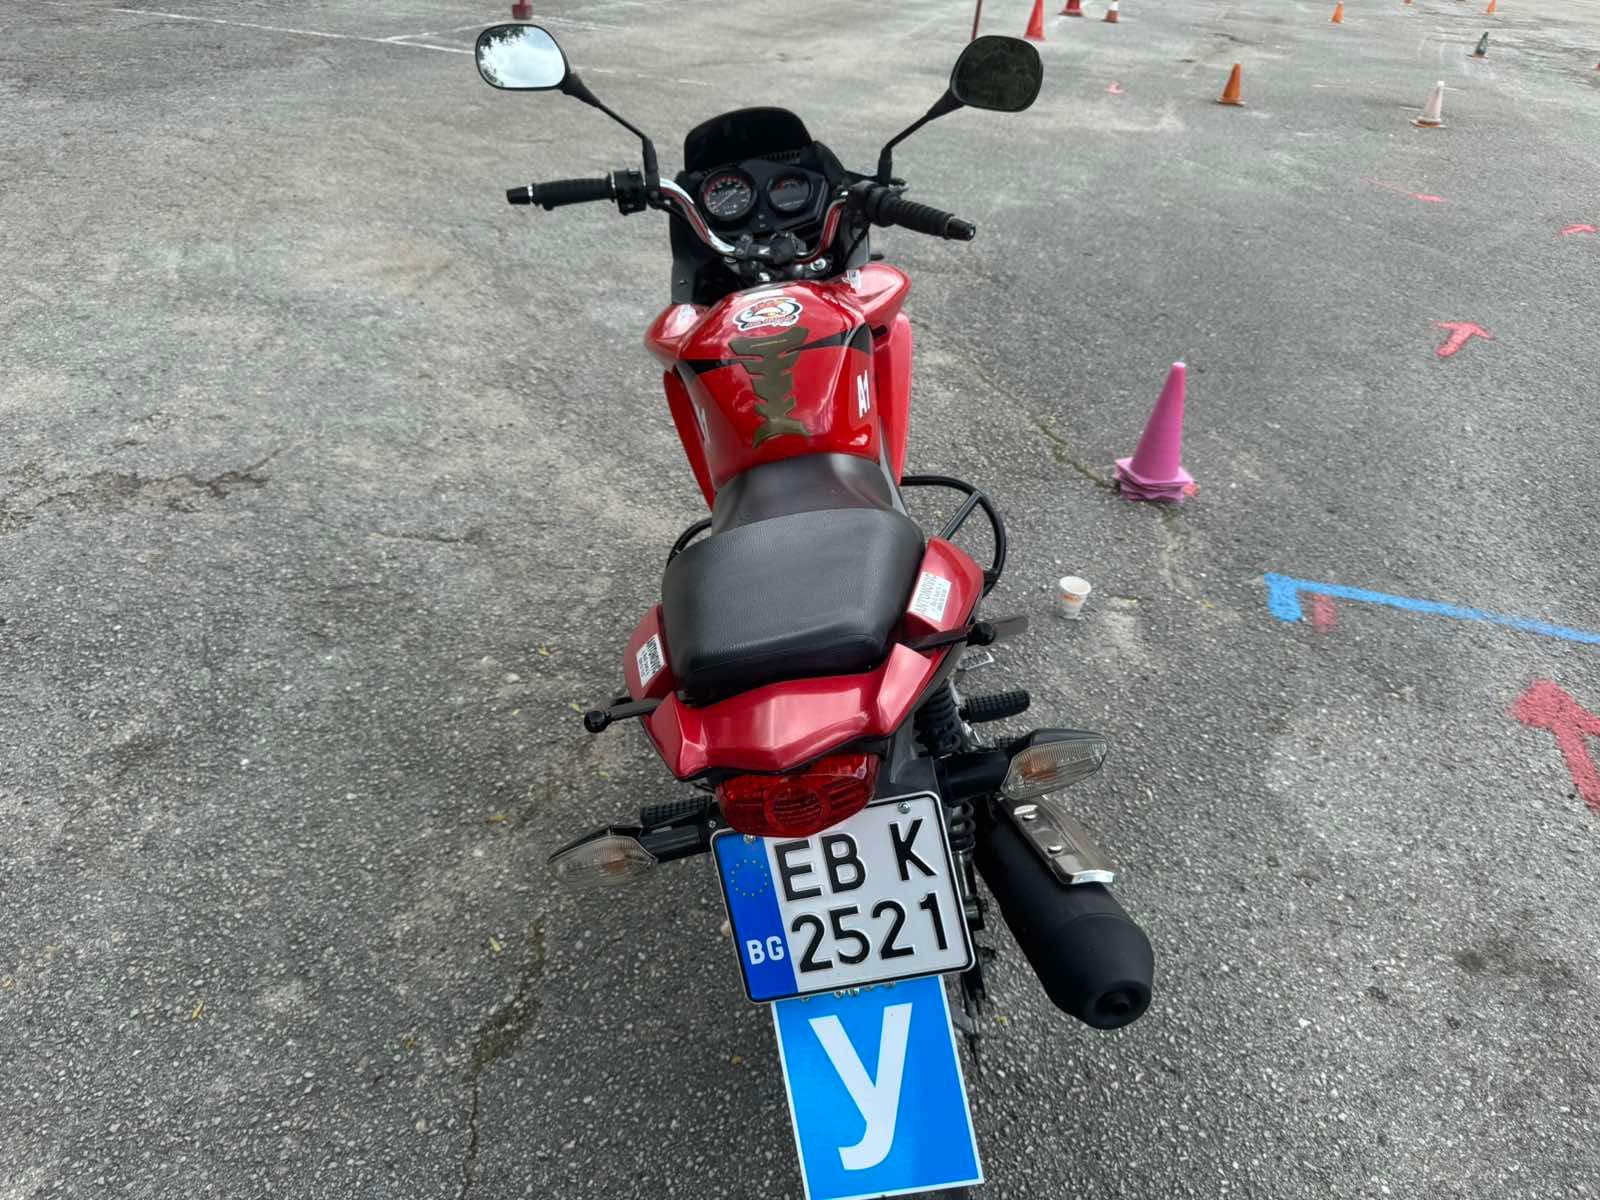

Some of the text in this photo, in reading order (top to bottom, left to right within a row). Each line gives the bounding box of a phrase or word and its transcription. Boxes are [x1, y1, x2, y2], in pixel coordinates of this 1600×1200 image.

[774, 818, 937, 901] EB K
[746, 936, 784, 965] BG
[791, 892, 948, 973] 2521
